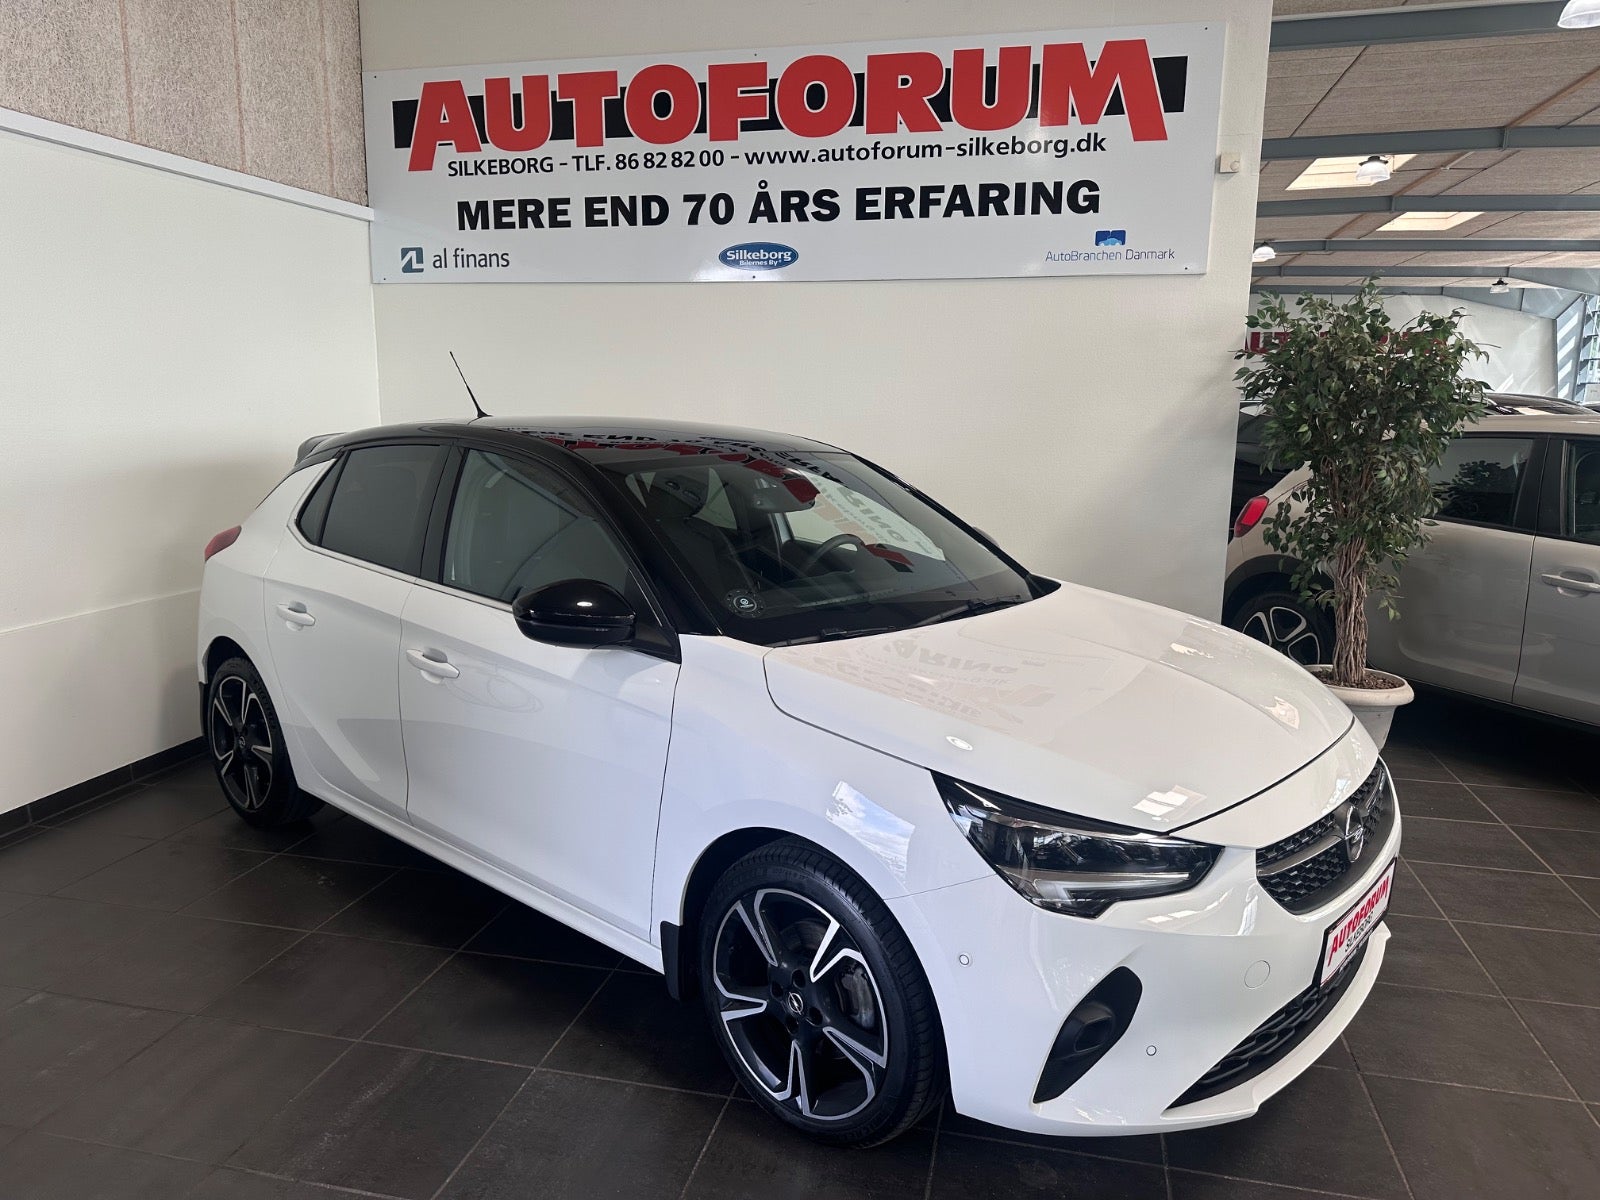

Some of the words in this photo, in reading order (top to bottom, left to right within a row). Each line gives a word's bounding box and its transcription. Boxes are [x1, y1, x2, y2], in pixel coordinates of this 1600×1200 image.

[408, 39, 1168, 172] AUTOFORUM
[447, 156, 553, 177] SILKEBORG
[572, 154, 611, 172] TLF.
[615, 152, 639, 170] 86
[643, 151, 668, 169] 82
[671, 150, 695, 168] 82
[699, 149, 724, 167] 00
[744, 132, 1107, 165] www.autoforum-silkeborg.dk
[457, 197, 572, 231] MERE
[584, 194, 670, 228] END
[682, 192, 735, 226] 70
[748, 179, 841, 224] ÅRS
[855, 179, 1100, 221] ERFARING
[432, 248, 448, 269] al
[452, 248, 510, 269] finans
[726, 249, 792, 262] Silkeborg
[1045, 249, 1122, 262] AutoBranchen
[1125, 248, 1175, 261] Danmark
[1327, 875, 1390, 968] AUTOFORUM
